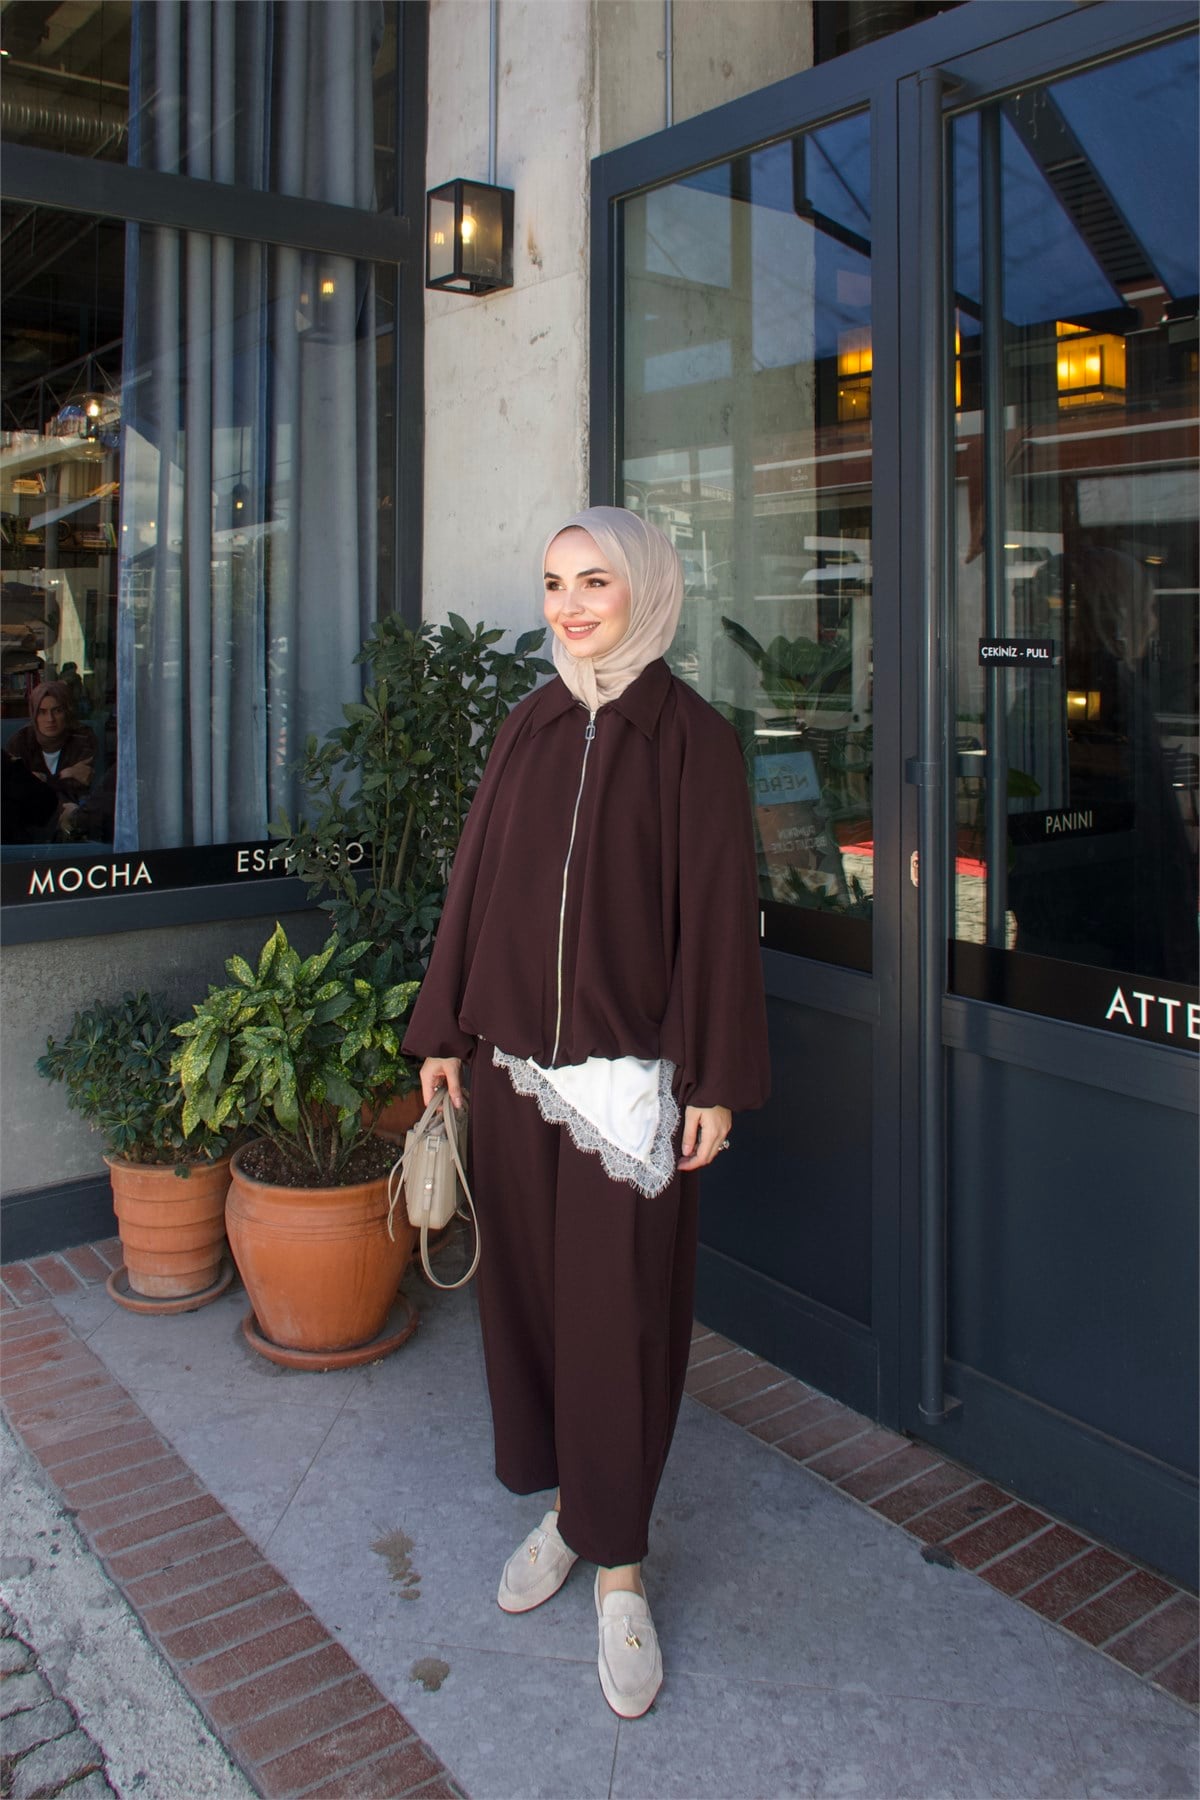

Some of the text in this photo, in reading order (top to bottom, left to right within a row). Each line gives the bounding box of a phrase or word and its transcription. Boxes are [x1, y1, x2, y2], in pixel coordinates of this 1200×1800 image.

[1026, 648, 1049, 658] PULL
[1045, 810, 1093, 834] PANINI
[28, 842, 364, 895] MOCHA ESPRSO
[1105, 986, 1200, 1040] ATTE
